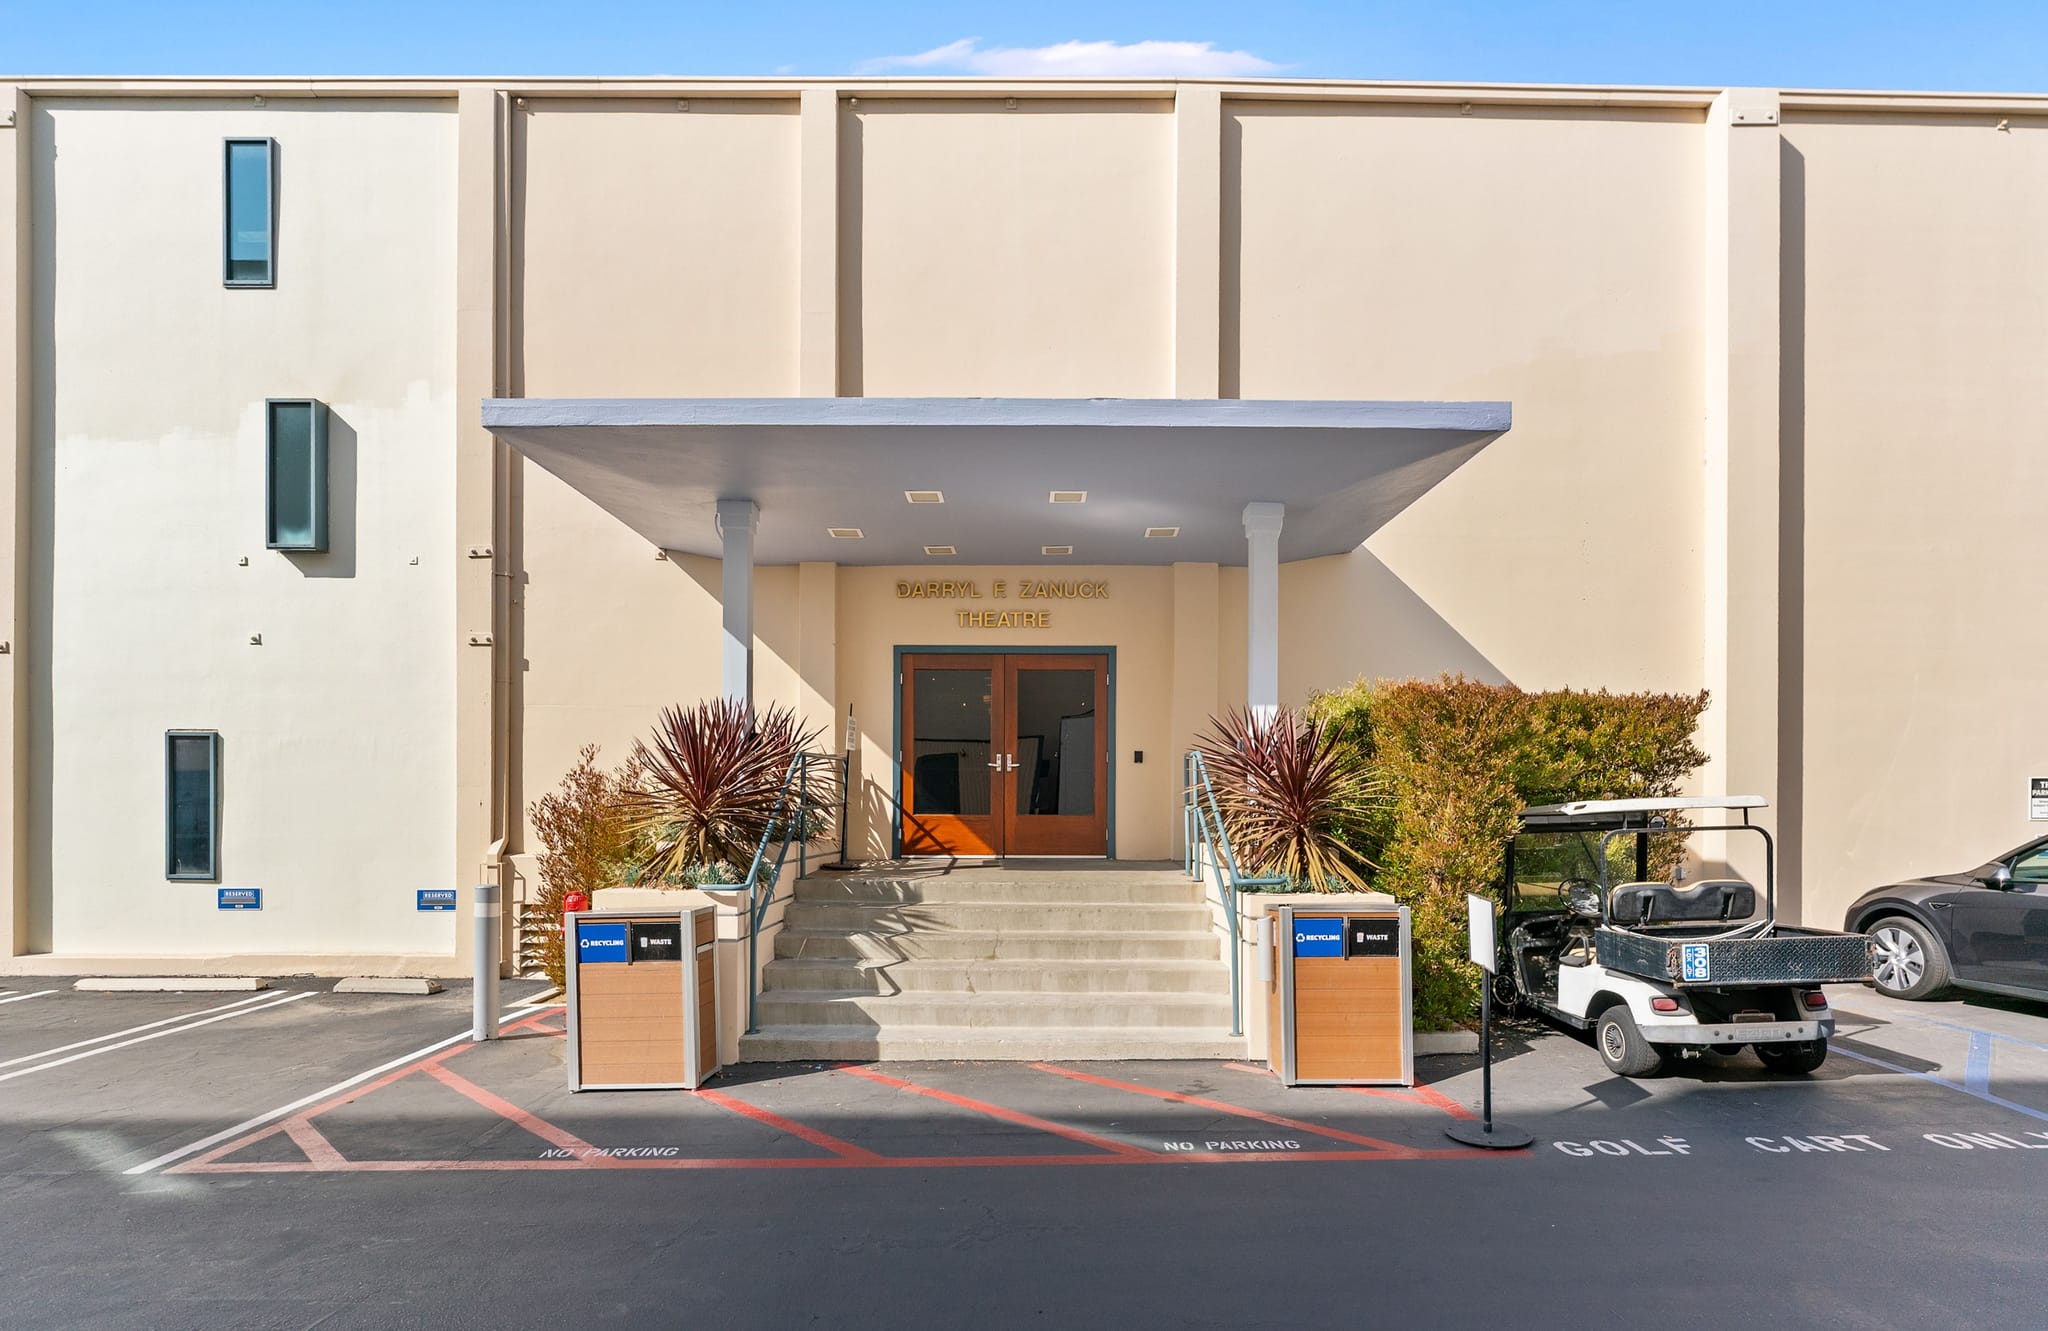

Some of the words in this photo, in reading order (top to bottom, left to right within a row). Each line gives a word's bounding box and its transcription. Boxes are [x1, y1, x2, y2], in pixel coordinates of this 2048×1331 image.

[897, 582, 982, 598] DARRYL
[1020, 582, 1108, 598] ZANUCK
[957, 611, 1050, 628] THEATRE
[590, 939, 624, 947] RECYCLING
[1694, 947, 1707, 978] 308
[538, 1149, 574, 1158] NO
[583, 1147, 680, 1157] PARKING
[1163, 1142, 1194, 1151] NO
[1205, 1140, 1301, 1150] PARKING
[1553, 1138, 1691, 1156] GOLF
[1745, 1135, 1891, 1152] CART
